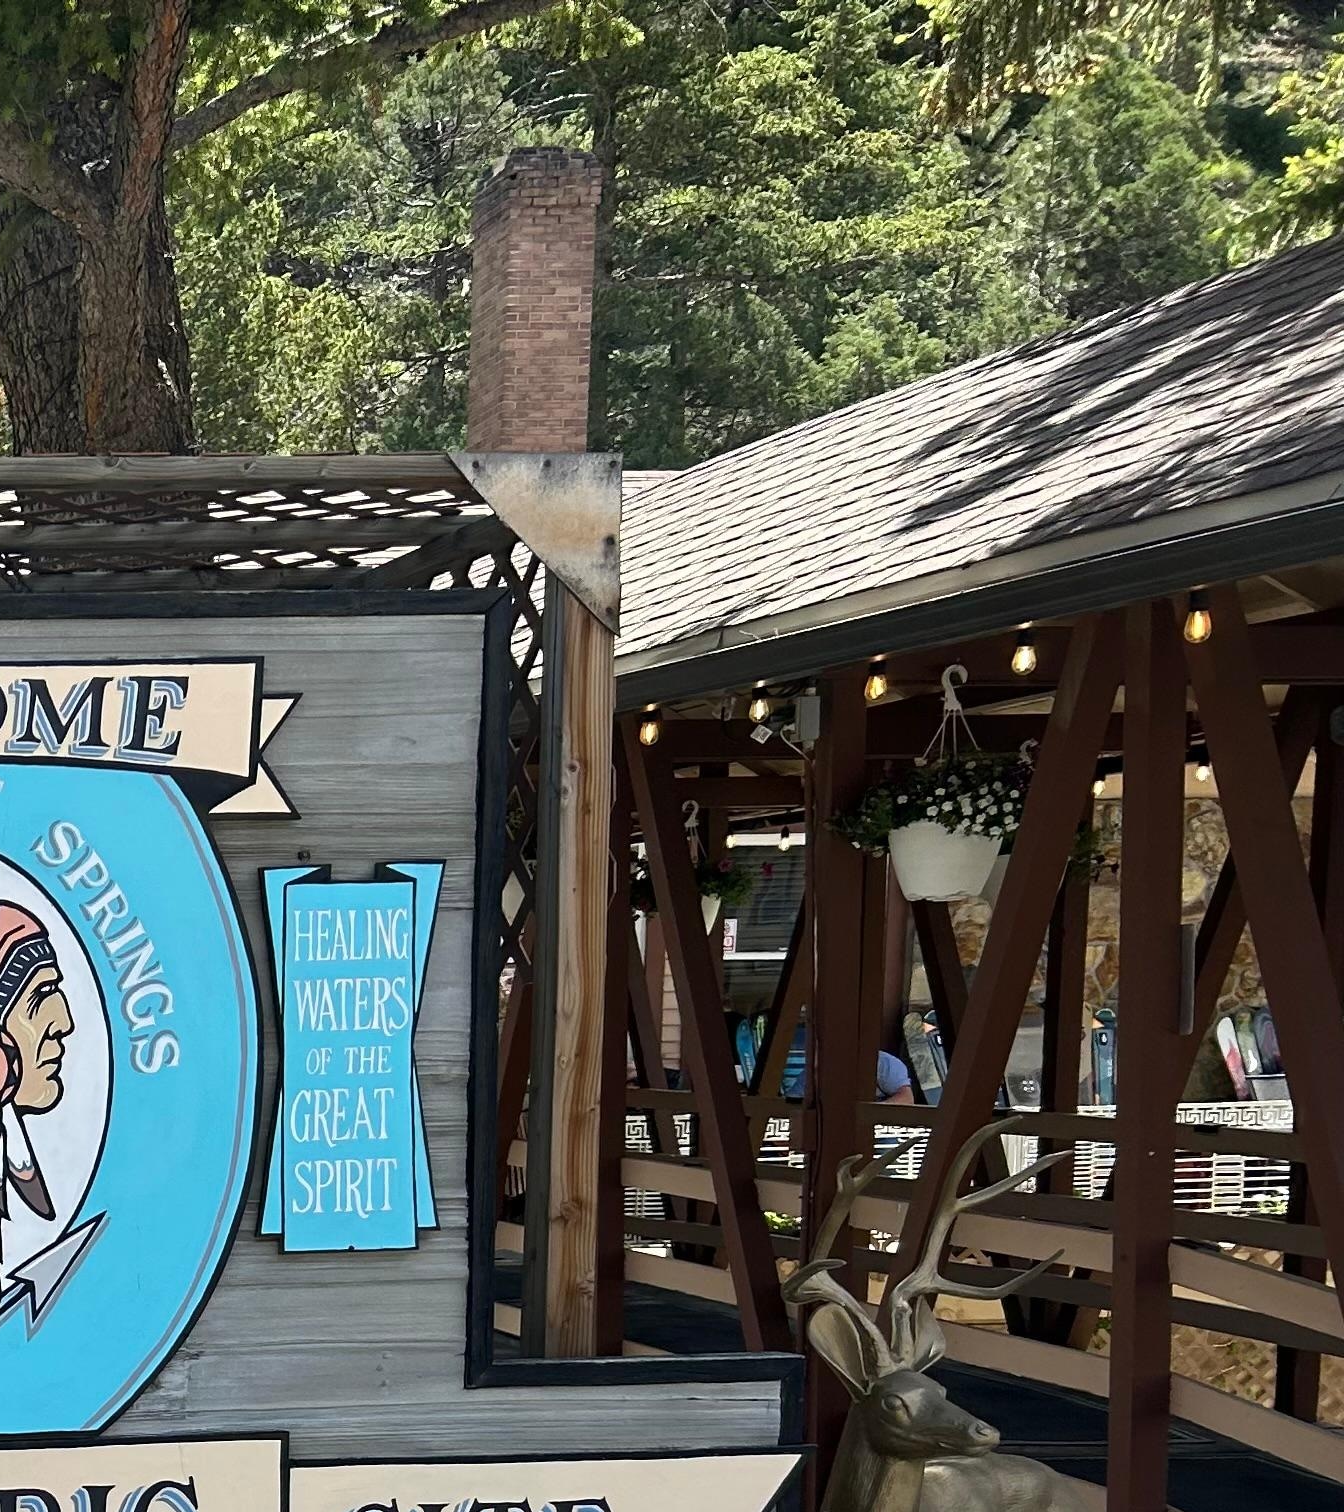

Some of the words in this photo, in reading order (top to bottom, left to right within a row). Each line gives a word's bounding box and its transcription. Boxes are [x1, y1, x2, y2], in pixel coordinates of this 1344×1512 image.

[28, 819, 181, 1074] SPRINGS
[293, 907, 410, 961] HEALING
[293, 976, 409, 1037] WATERS
[305, 1047, 333, 1075] OF
[344, 1046, 392, 1075] THE
[290, 1087, 395, 1148] GREAT
[292, 1157, 398, 1219] SPIRIT
